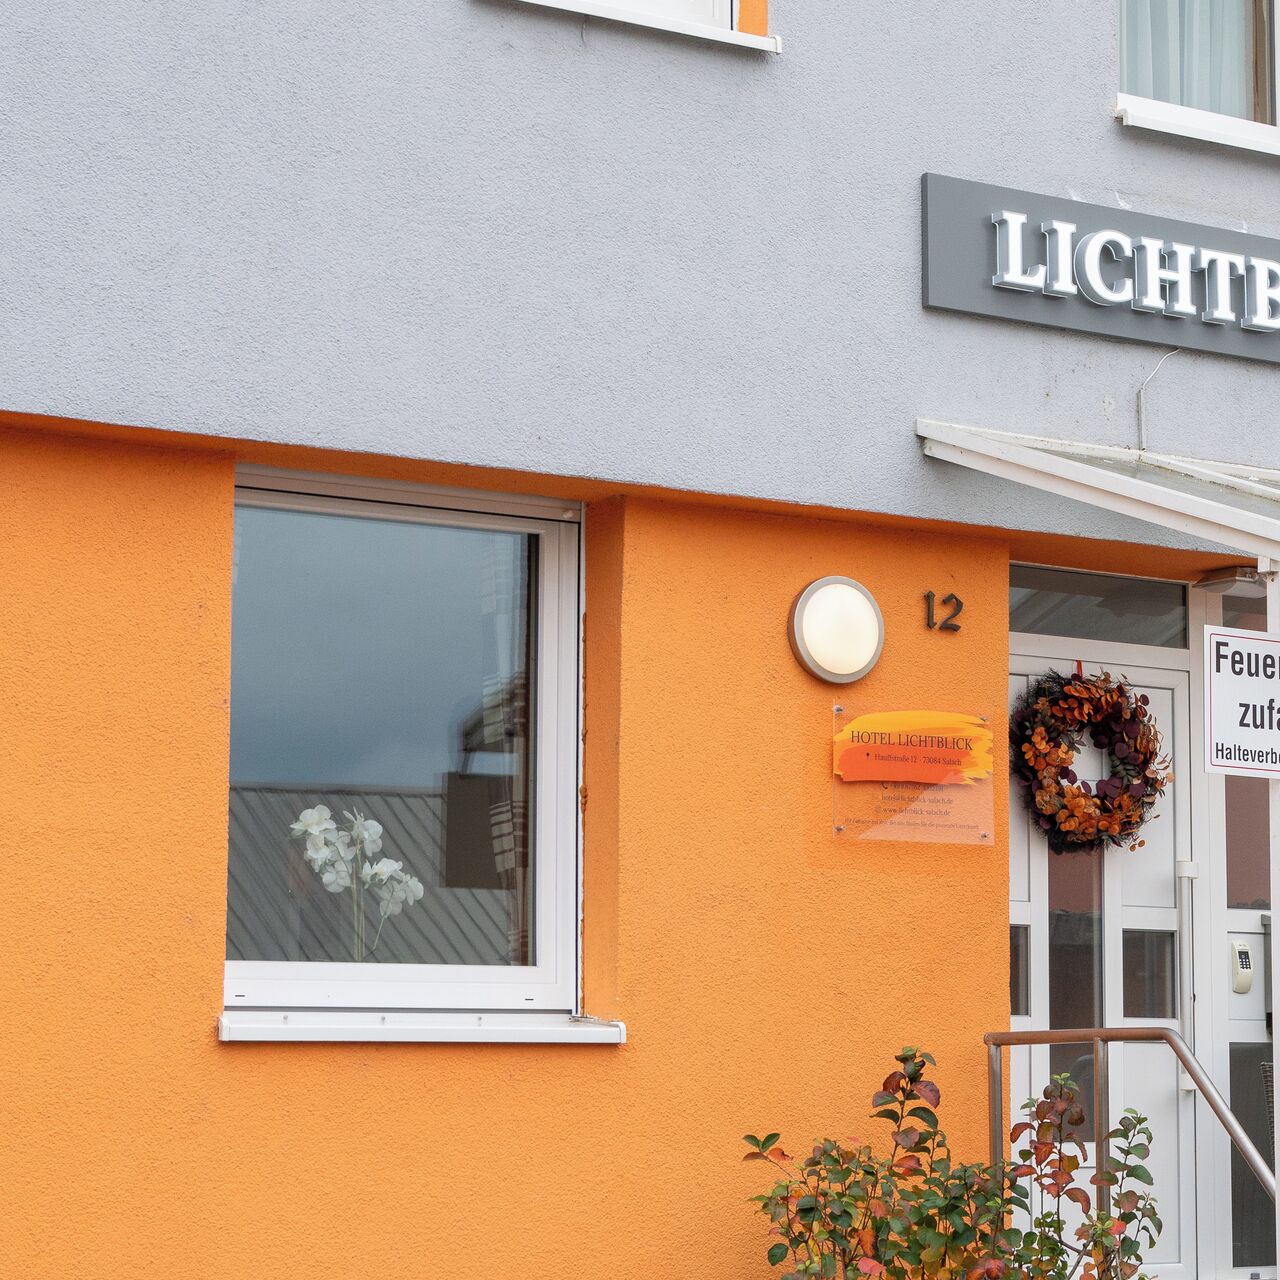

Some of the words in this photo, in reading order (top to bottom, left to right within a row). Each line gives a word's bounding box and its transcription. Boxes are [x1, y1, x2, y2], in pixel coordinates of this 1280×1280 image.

[925, 590, 965, 632] 12
[851, 730, 895, 745] HOTEL
[898, 733, 973, 750] LICHTBLICK
[942, 758, 962, 766] Salach
